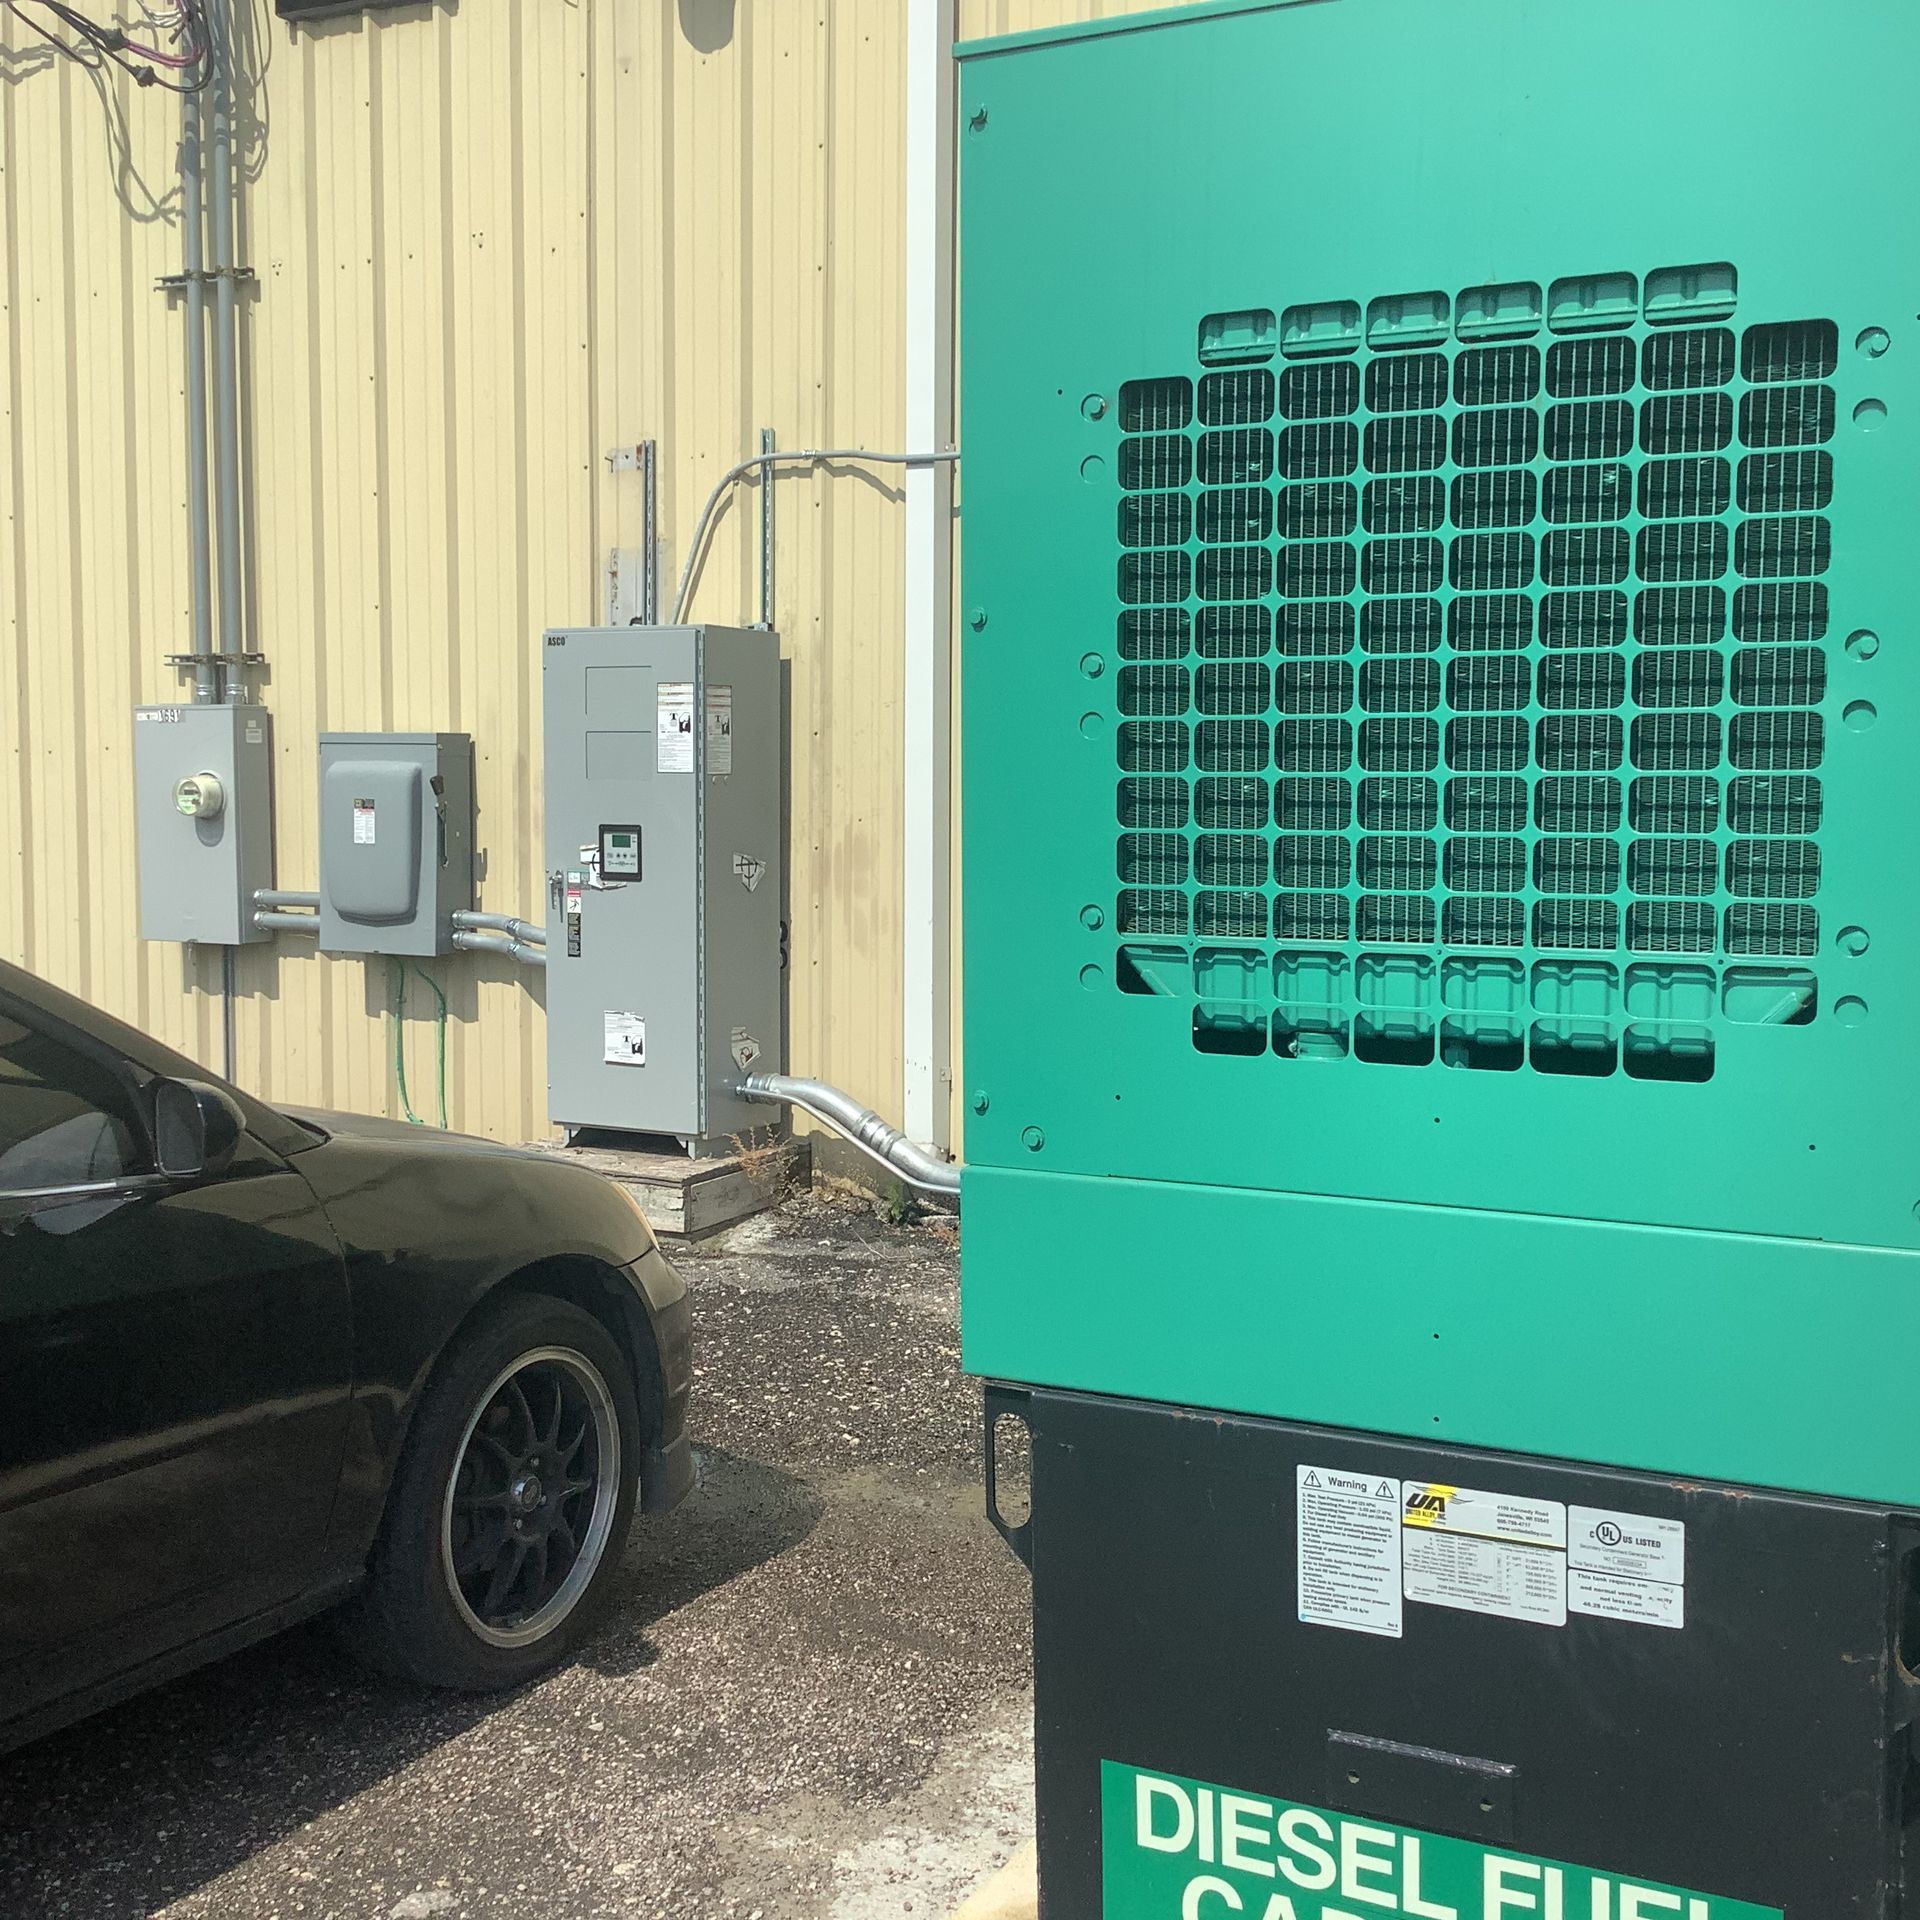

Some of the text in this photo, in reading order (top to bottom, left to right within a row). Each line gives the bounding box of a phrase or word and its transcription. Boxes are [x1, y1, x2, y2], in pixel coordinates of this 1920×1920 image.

[547, 636, 566, 646] ASCO
[1328, 1476, 1367, 1492] Warning
[1636, 1538, 1661, 1548] LISTED
[1609, 1578, 1636, 1587] requires
[1594, 1587, 1616, 1595] normal
[1136, 1774, 1457, 1920] DIESEL
[1484, 1853, 1708, 1920] FU
